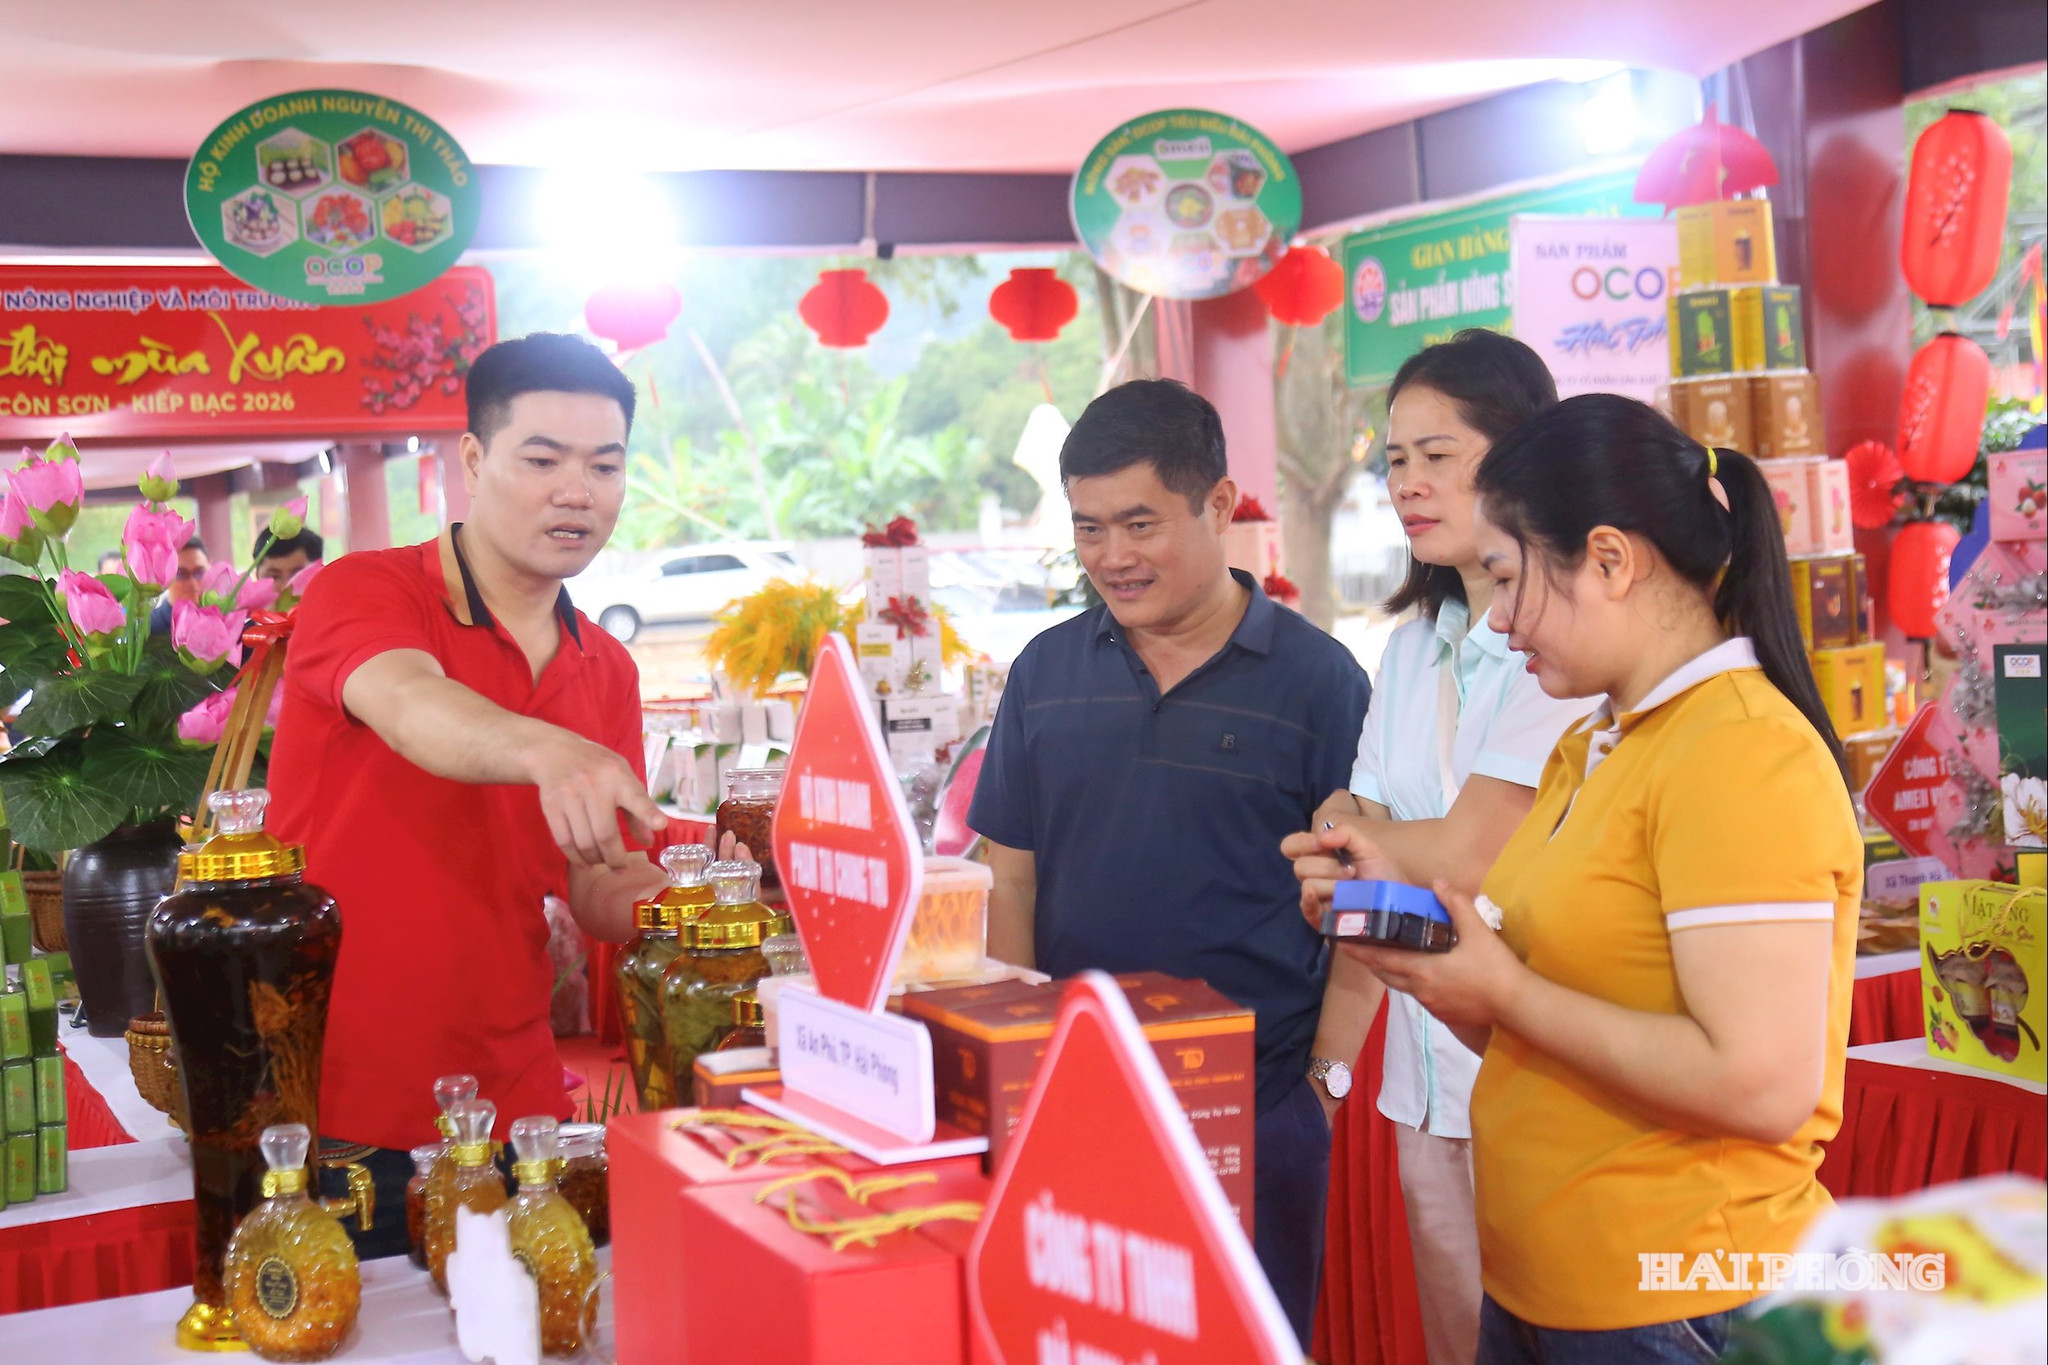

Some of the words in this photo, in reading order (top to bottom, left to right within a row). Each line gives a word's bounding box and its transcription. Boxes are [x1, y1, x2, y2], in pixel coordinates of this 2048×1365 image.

[198, 161, 221, 192] HỘ
[210, 121, 250, 161] KINH
[250, 97, 317, 129] DOANH
[305, 254, 383, 276] OCOP
[5, 288, 70, 310] NÔNG
[76, 290, 153, 314] NGHIỆP
[159, 288, 187, 310] VÀ
[189, 288, 229, 310] MÔI
[1390, 279, 1418, 328] SẢN
[1421, 266, 1459, 320] PHẨM
[0, 392, 50, 416] CÔN
[58, 391, 109, 415] SƠN
[132, 389, 184, 413] KIẾP
[190, 393, 236, 417] BẠC
[242, 392, 295, 412] 2026
[1999, 905, 2029, 923] NG
